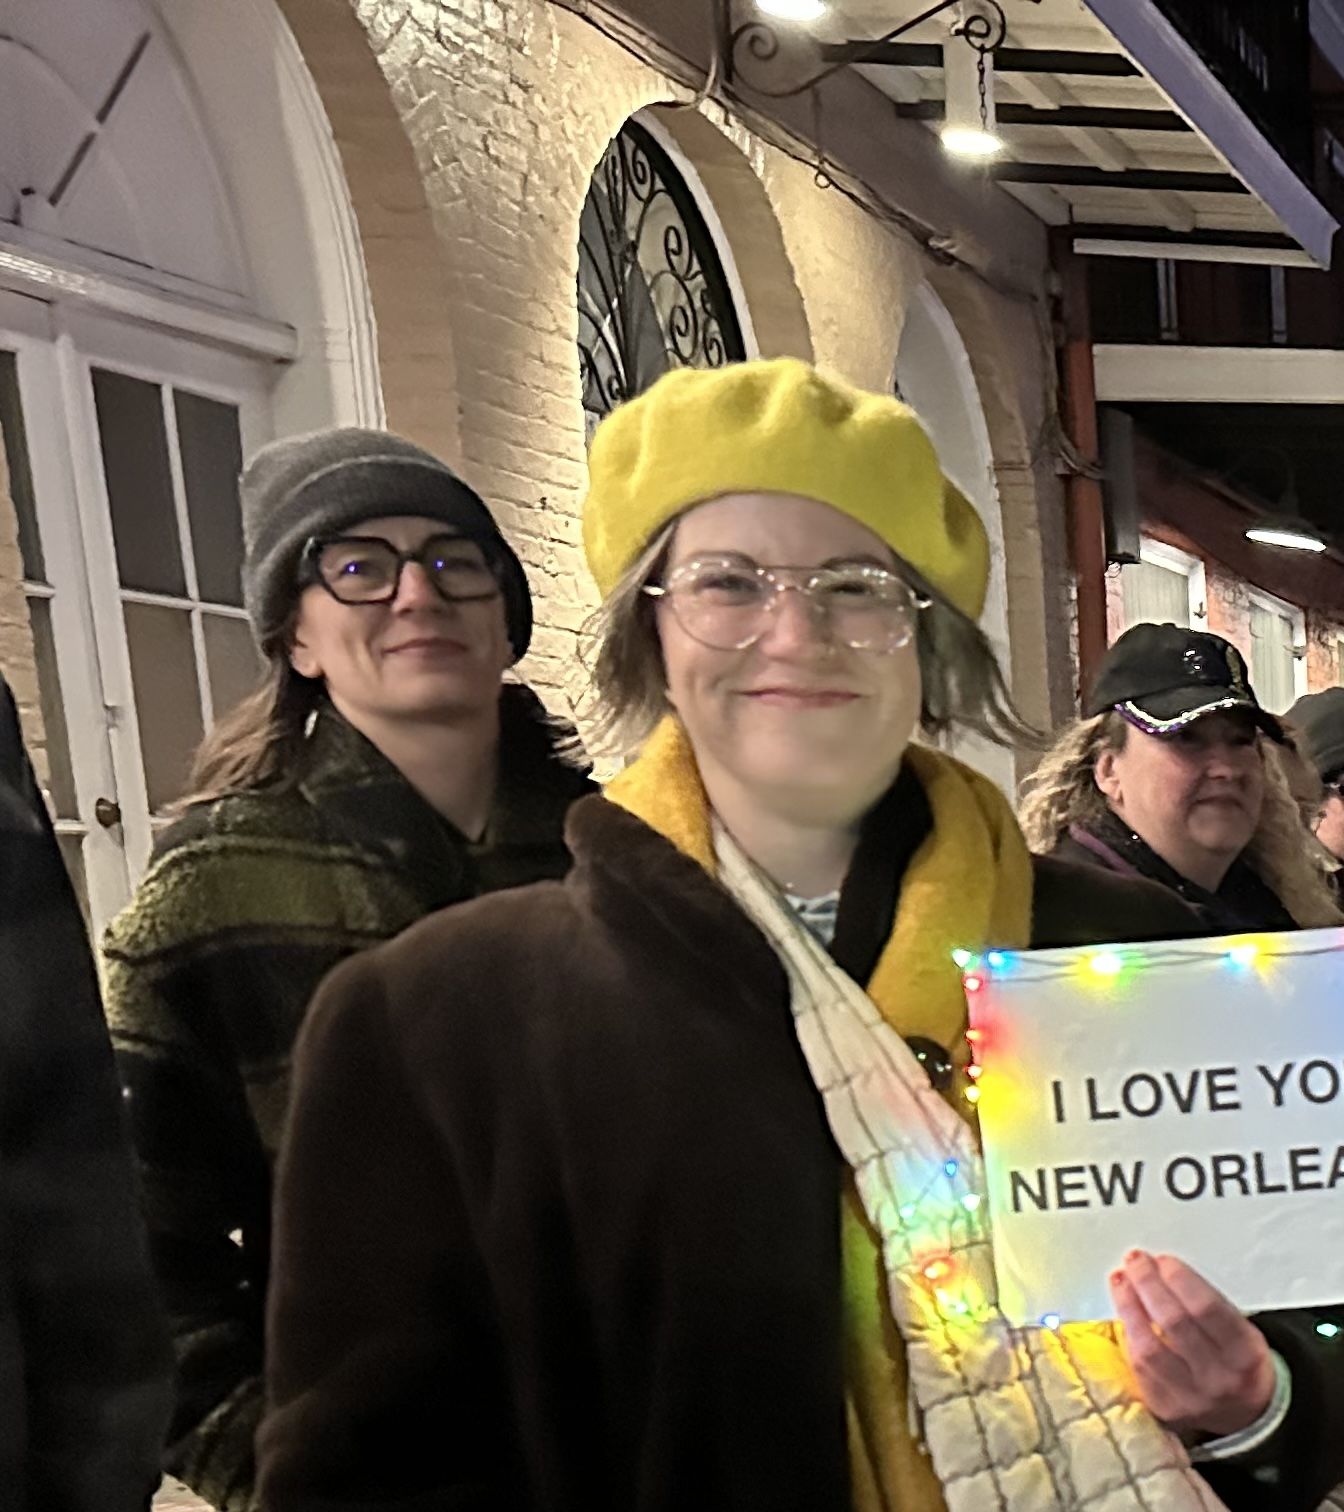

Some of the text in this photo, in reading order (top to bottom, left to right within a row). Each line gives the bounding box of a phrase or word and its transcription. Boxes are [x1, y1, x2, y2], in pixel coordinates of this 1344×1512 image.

[1051, 1079, 1065, 1123] I
[1086, 1067, 1241, 1121] LOVE
[1009, 1160, 1145, 1214] NEW
